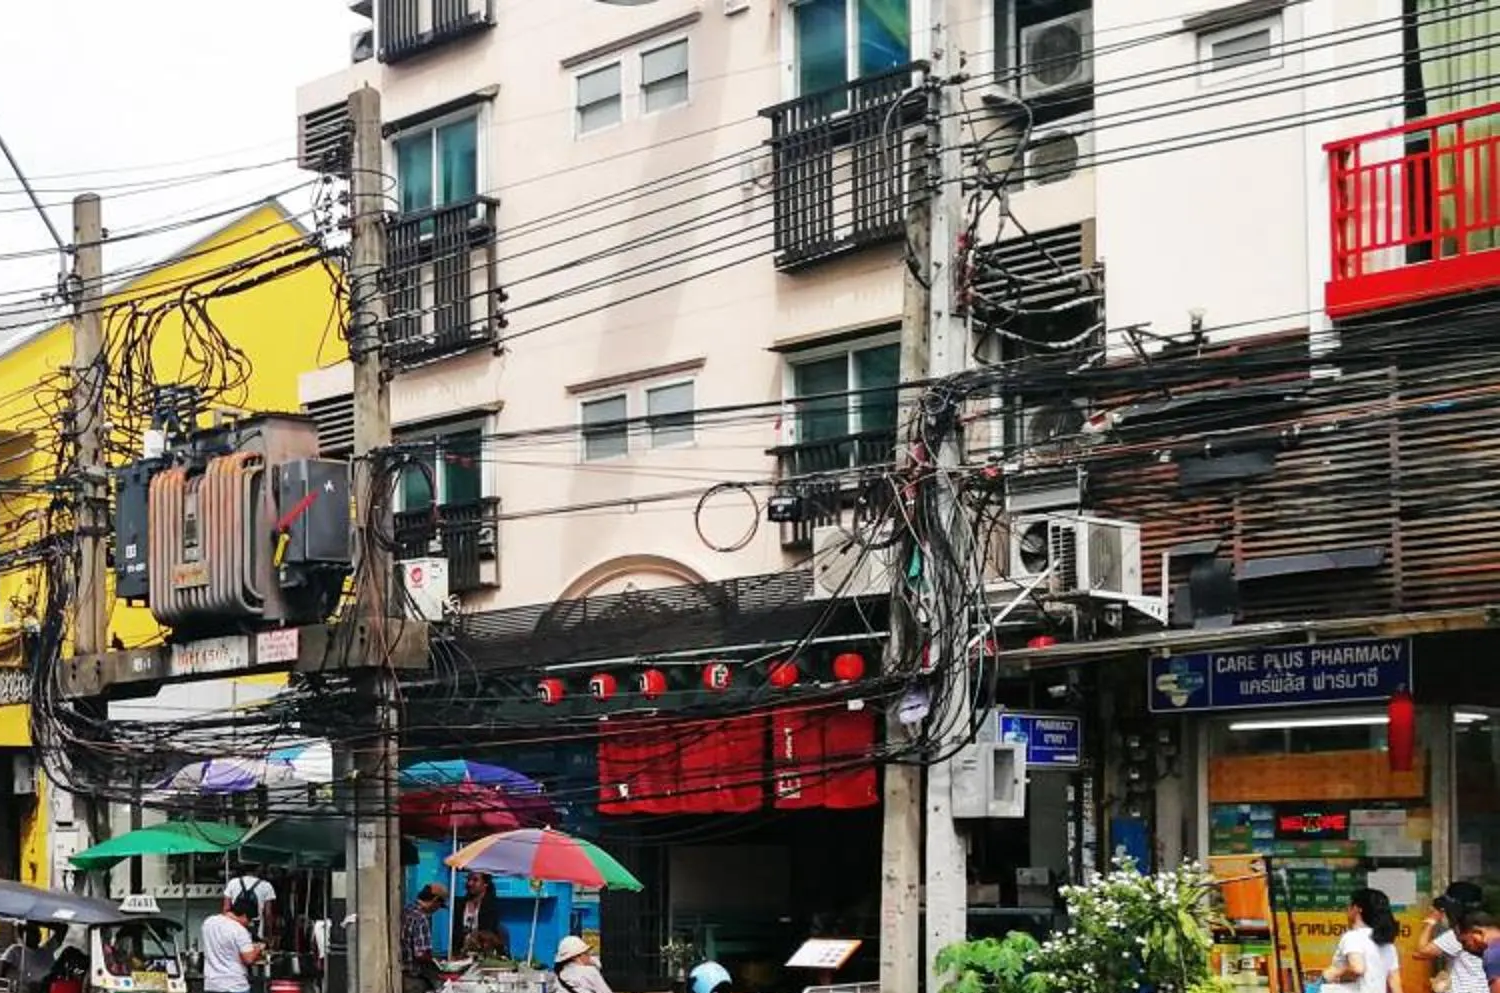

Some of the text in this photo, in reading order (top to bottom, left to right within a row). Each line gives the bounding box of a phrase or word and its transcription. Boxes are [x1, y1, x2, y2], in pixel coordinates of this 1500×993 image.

[1216, 644, 1402, 673] CARE PLUS PHARMACY
